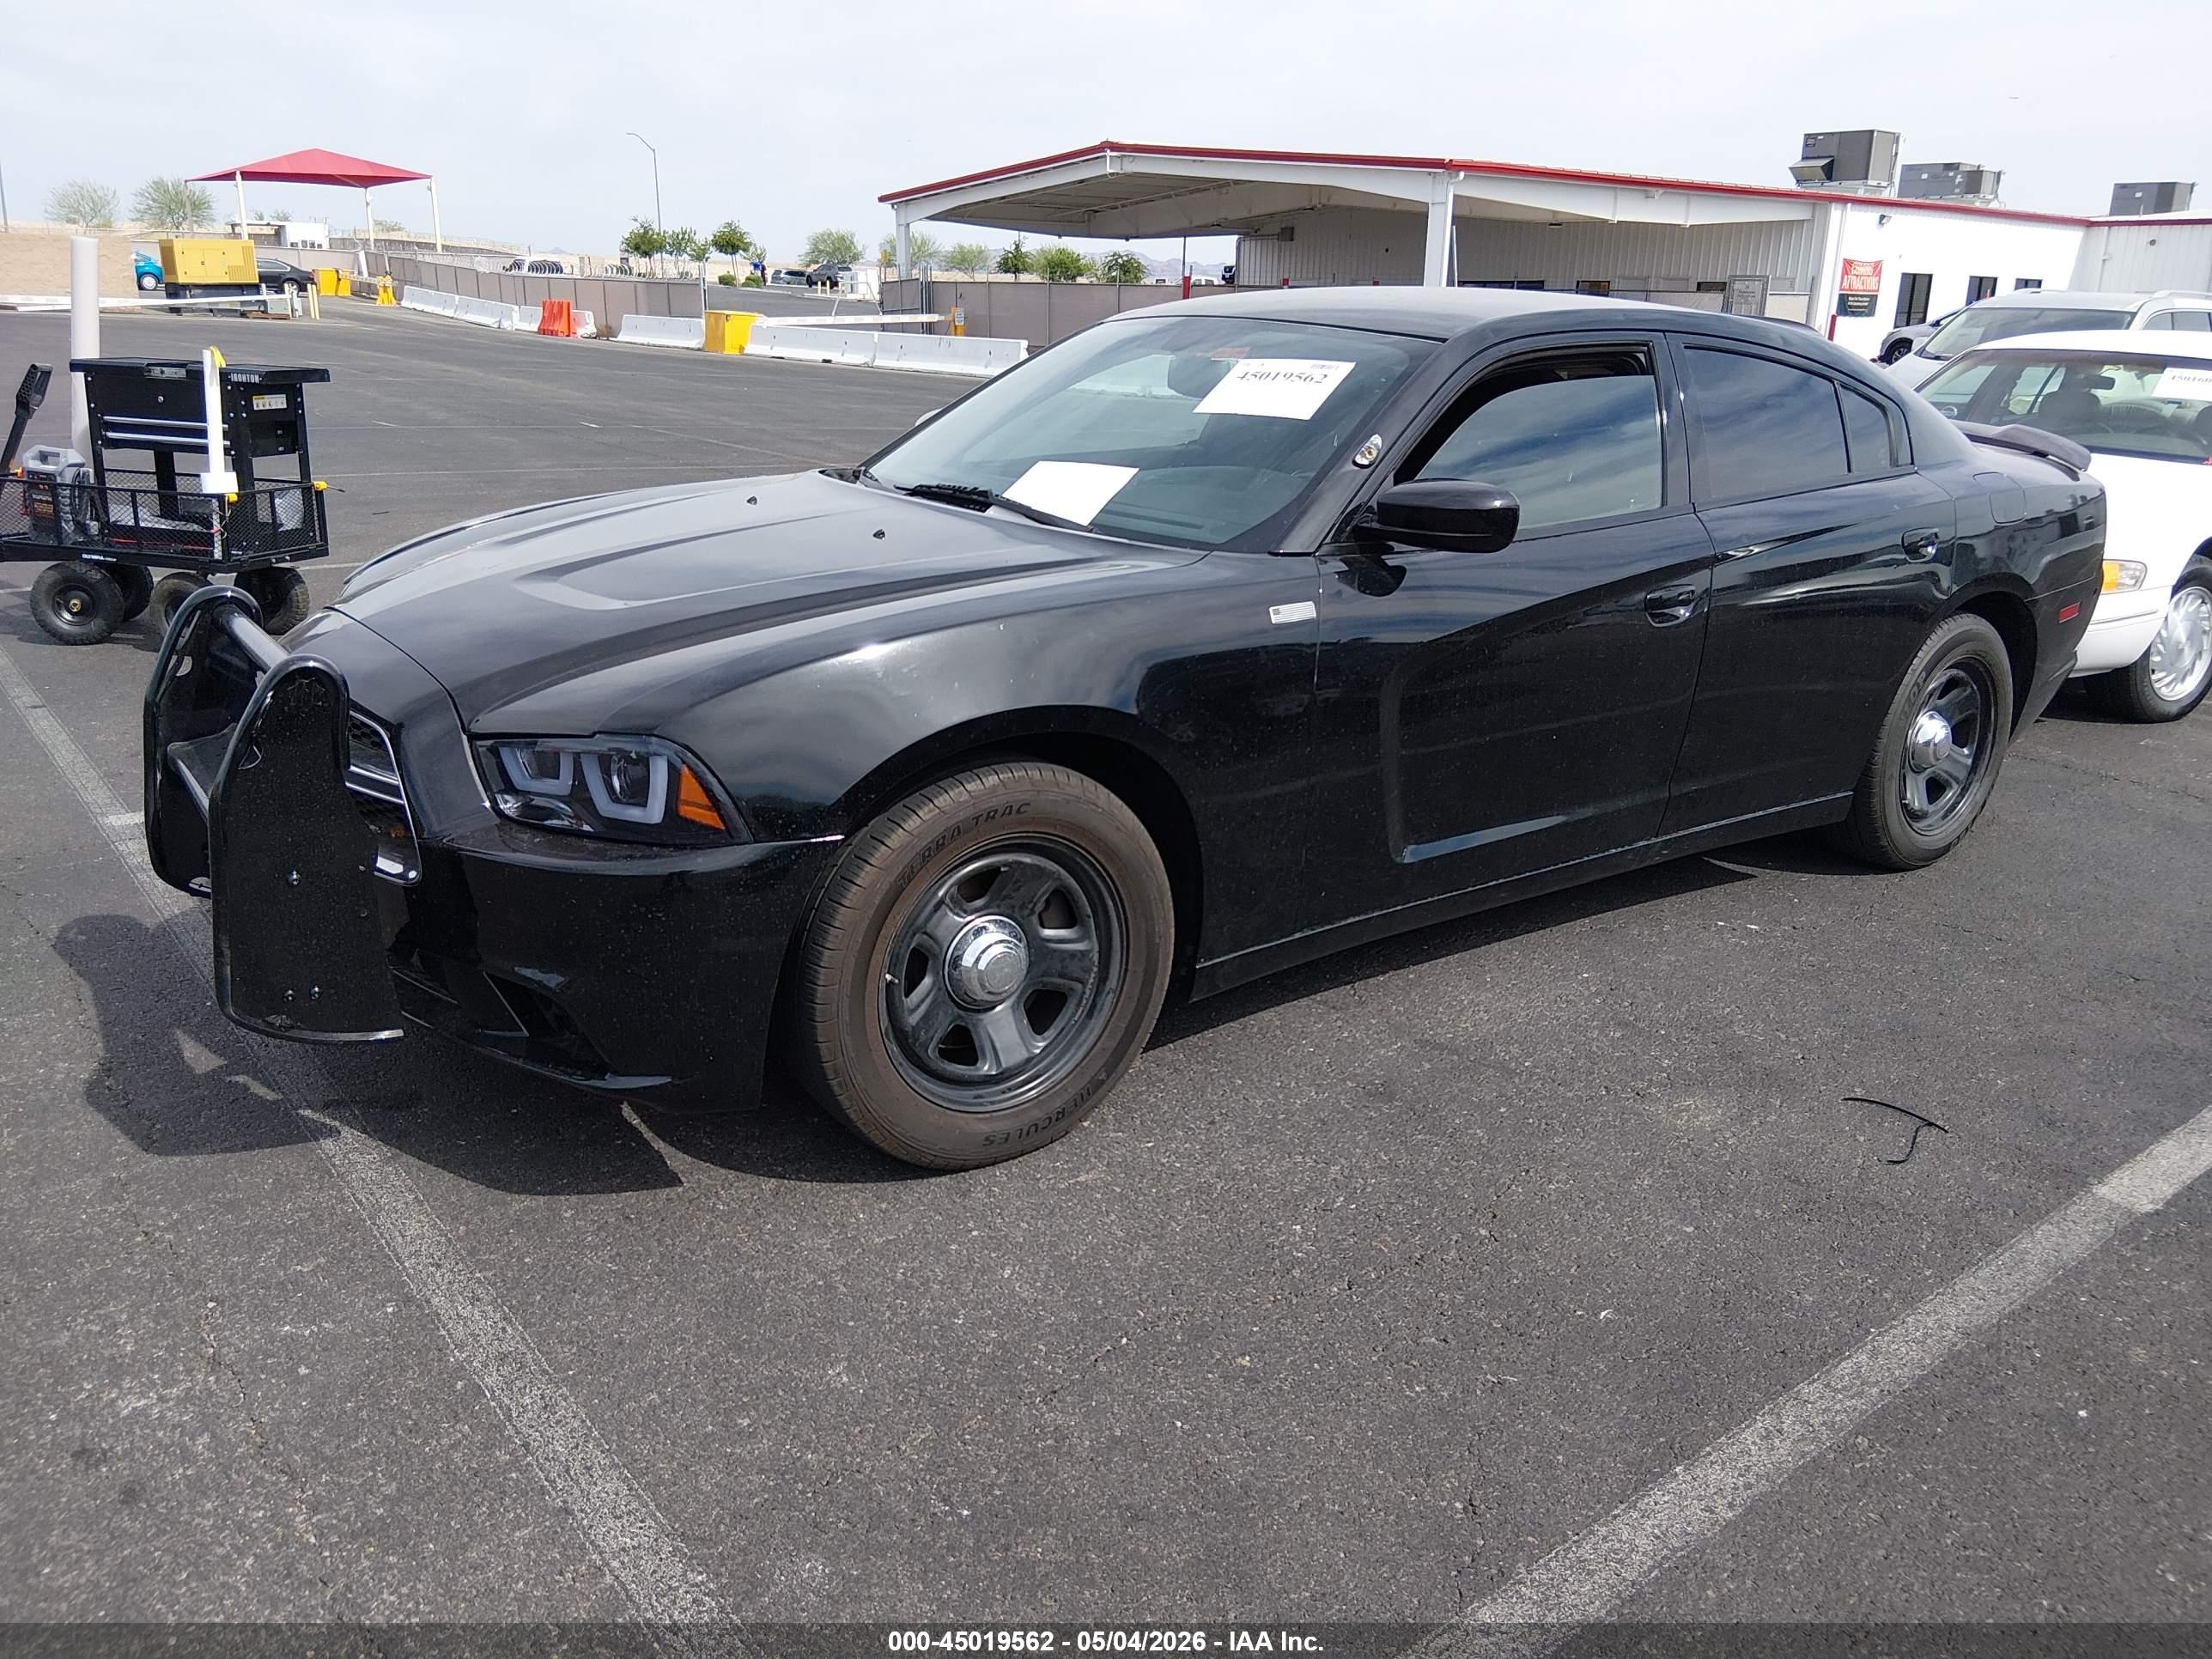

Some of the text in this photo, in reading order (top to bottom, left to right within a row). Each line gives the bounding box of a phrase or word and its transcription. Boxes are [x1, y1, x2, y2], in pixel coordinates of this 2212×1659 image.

[1237, 370, 1328, 385] 45019562
[896, 802, 1031, 889] TERRA TRAC
[981, 1085, 1092, 1147] HERCULES
